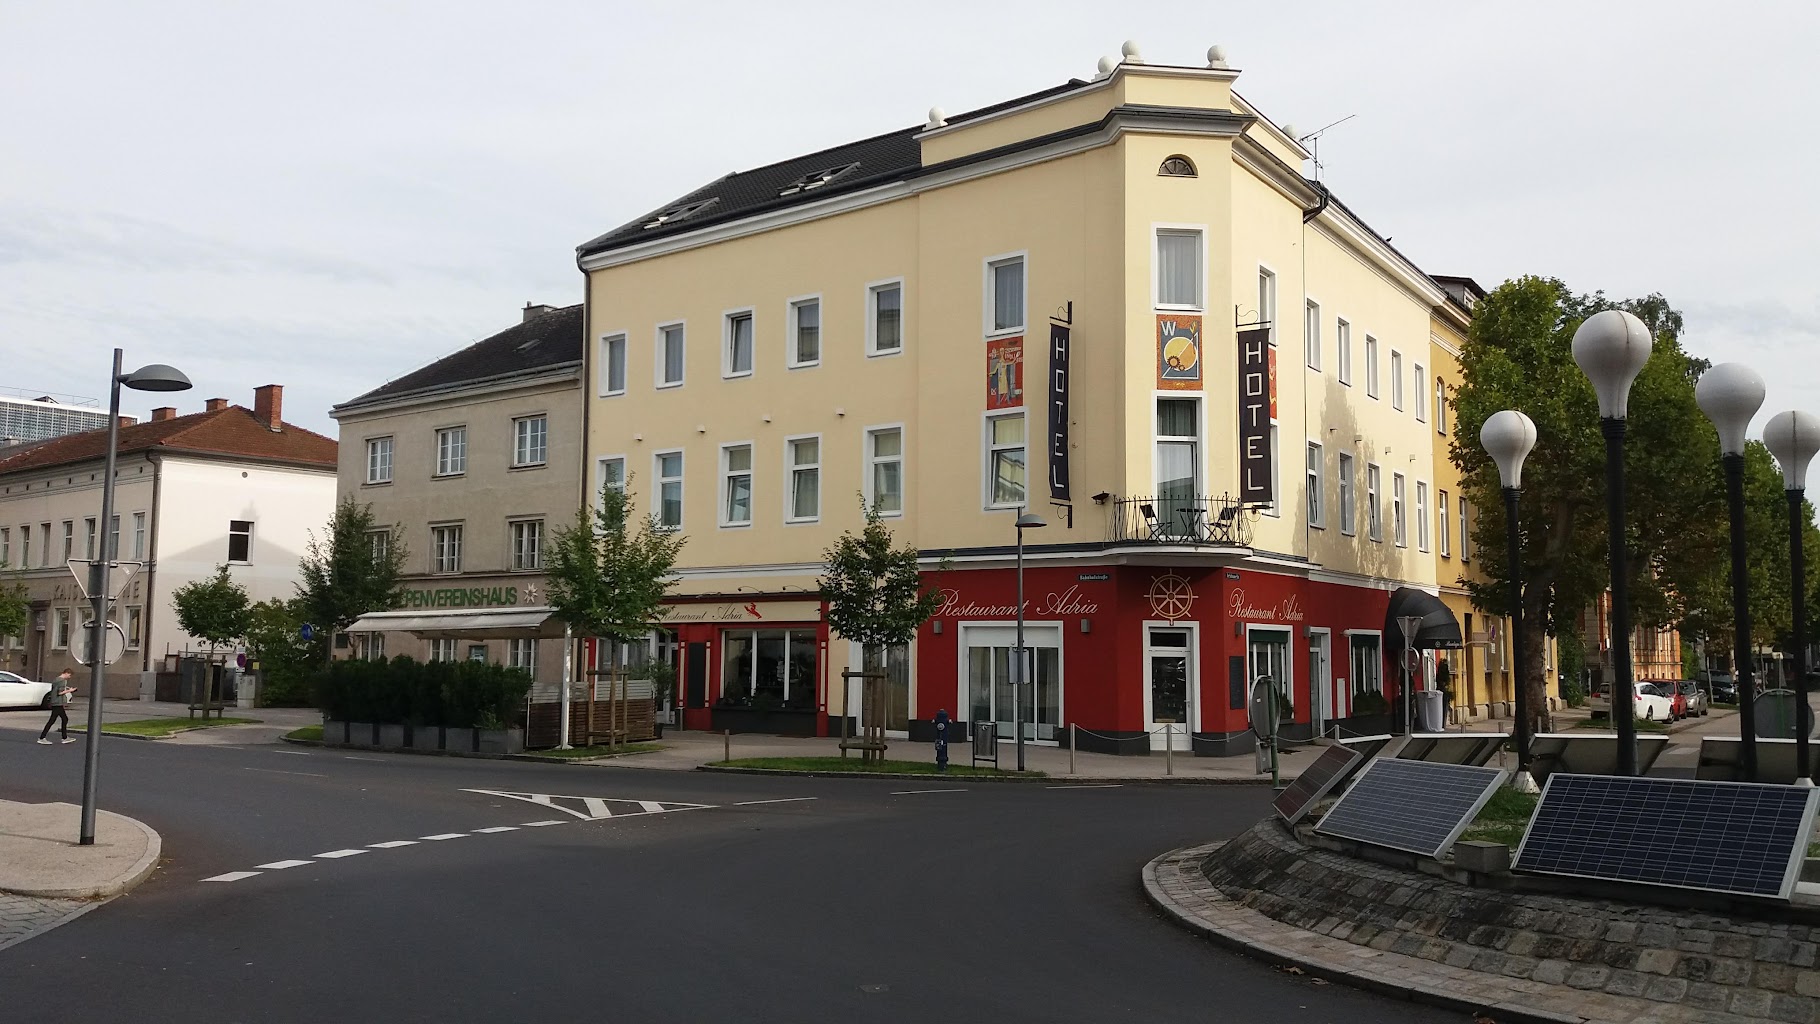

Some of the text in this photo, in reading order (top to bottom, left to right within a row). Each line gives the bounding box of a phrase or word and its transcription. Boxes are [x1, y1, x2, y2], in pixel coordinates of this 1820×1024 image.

[1053, 336, 1066, 489] HOTEL
[1245, 340, 1265, 492] HOTEL
[711, 603, 743, 621] Adria
[932, 584, 1099, 617] Restaurant Adria
[1228, 587, 1304, 621] Restaurant Adria
